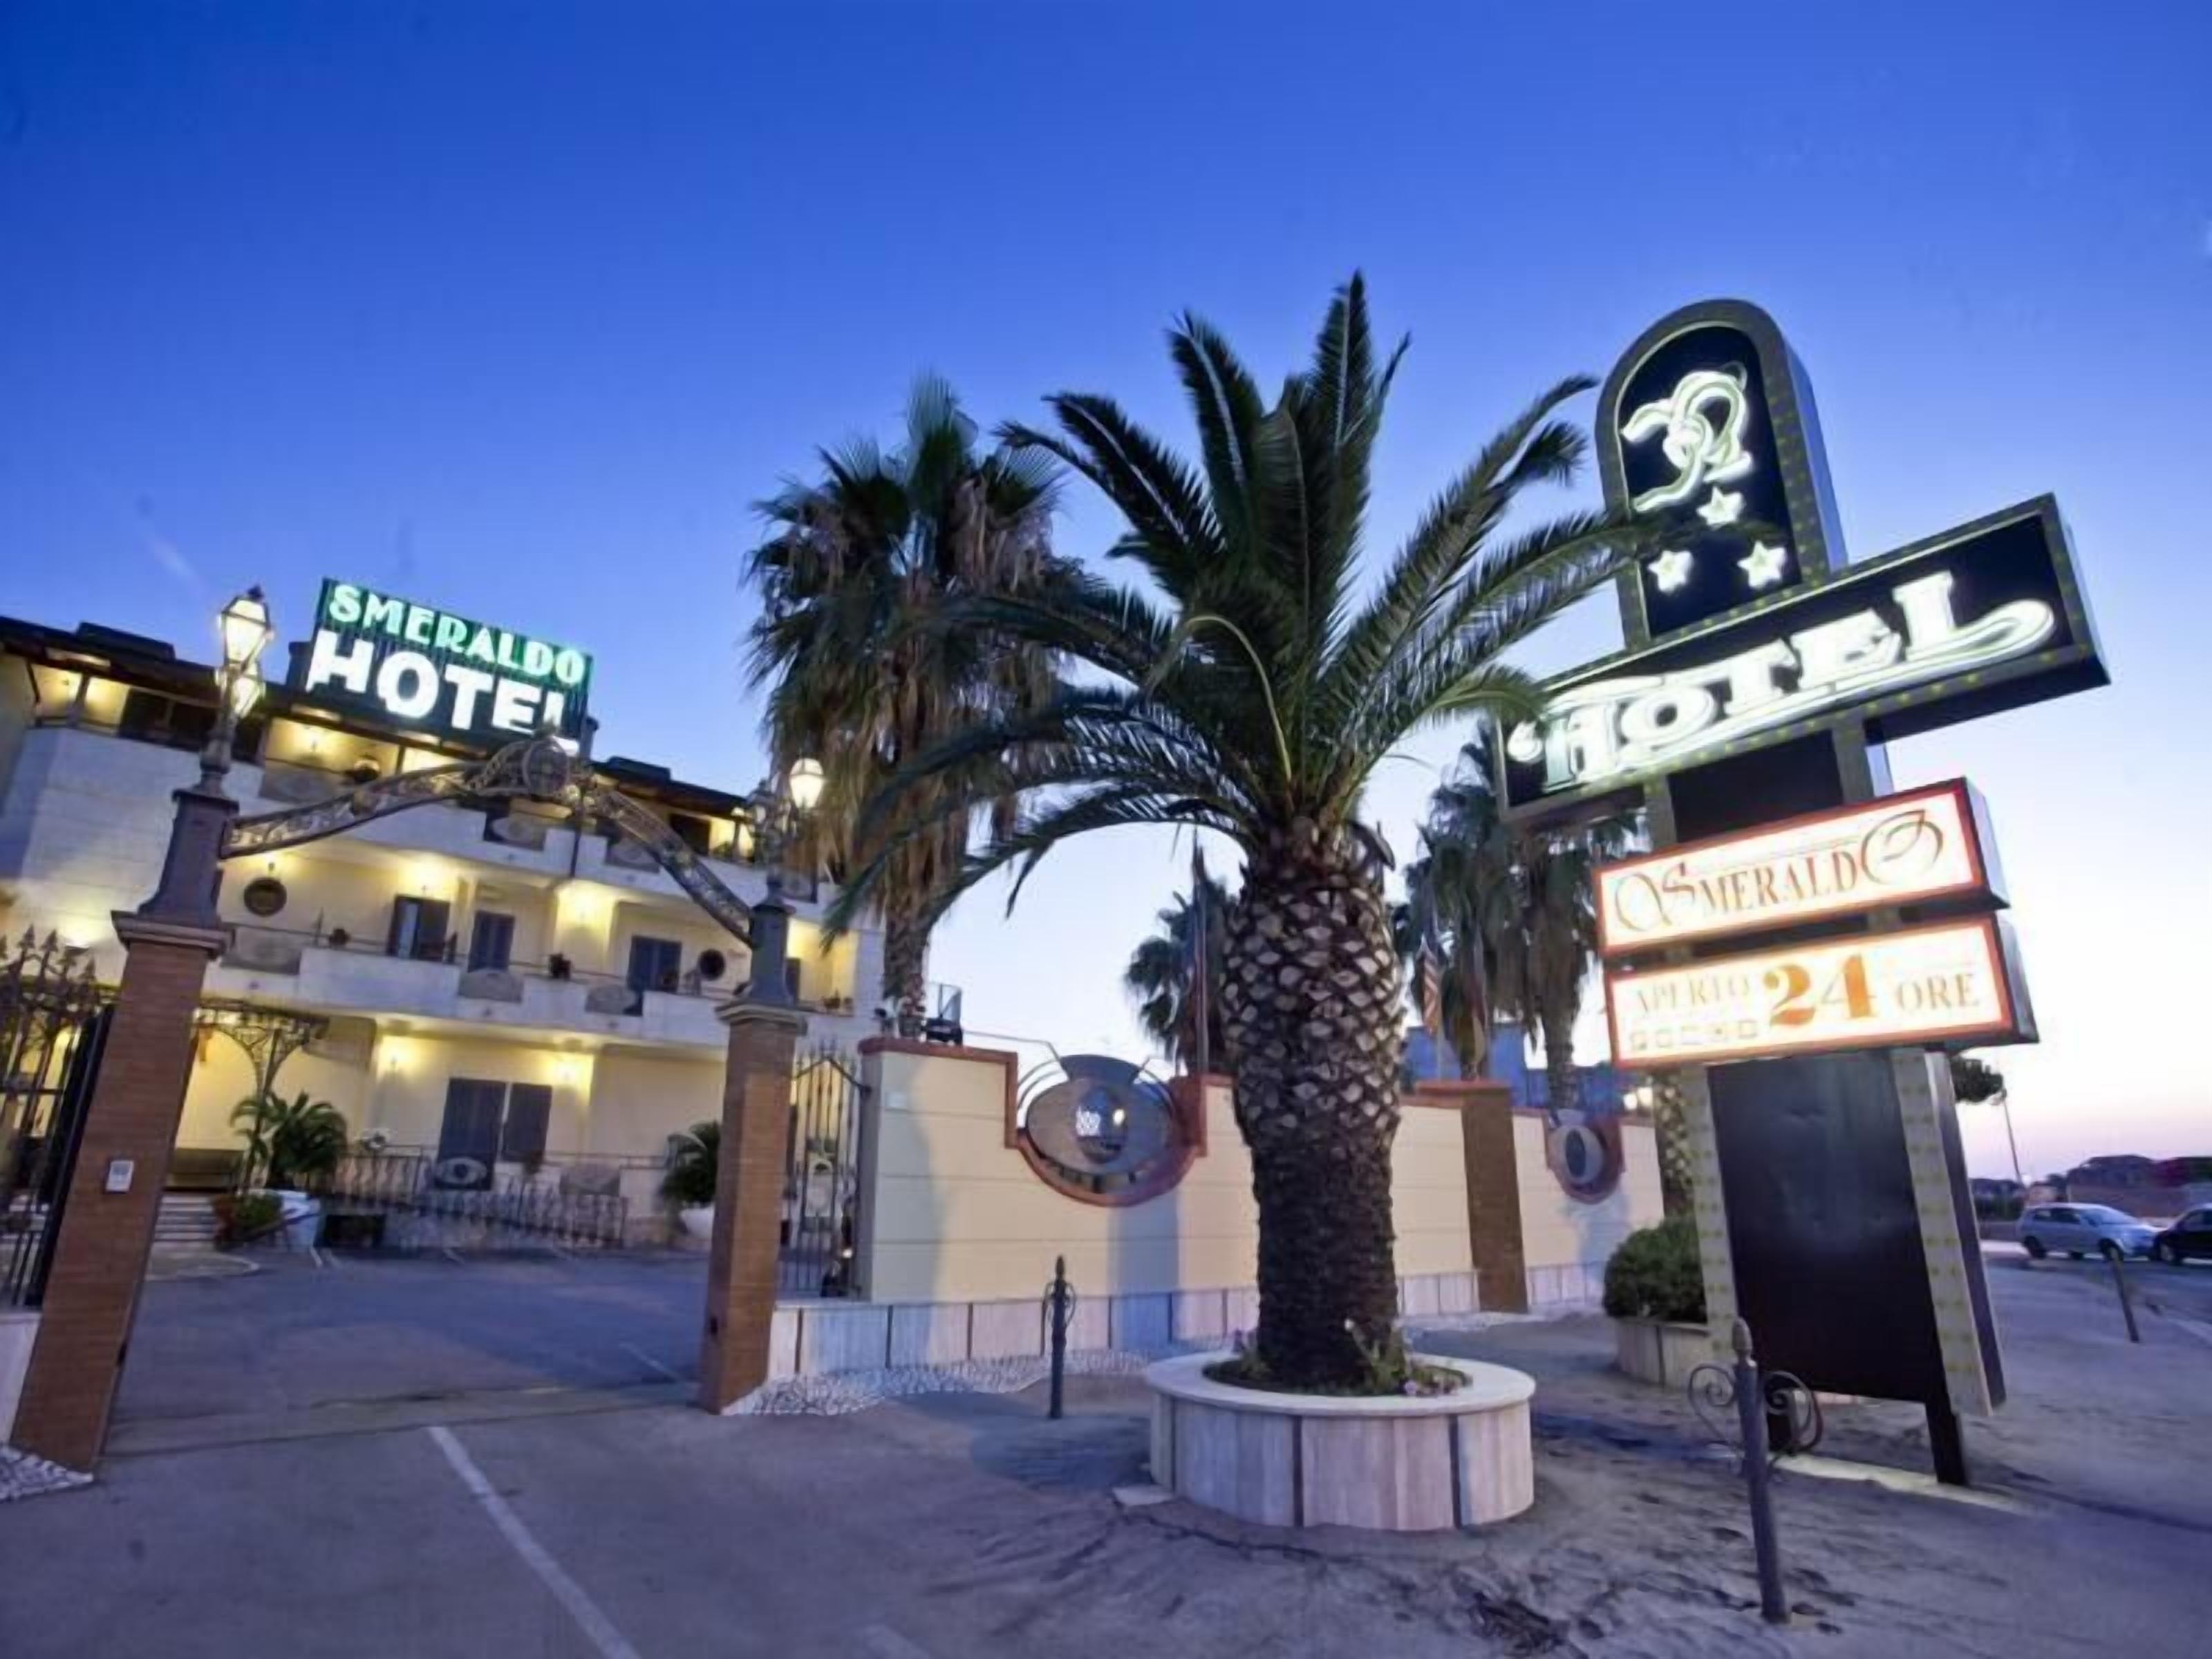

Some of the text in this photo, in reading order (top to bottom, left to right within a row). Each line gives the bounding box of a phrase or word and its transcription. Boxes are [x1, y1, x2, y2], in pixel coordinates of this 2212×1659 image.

[305, 628, 579, 757] HOTEL
[329, 584, 585, 685] SMERALDO
[1507, 571, 2054, 792] HOTEL
[1615, 808, 1944, 932] SMERALDO
[1765, 954, 1876, 1028] 24
[1897, 971, 1983, 1011] ORE
